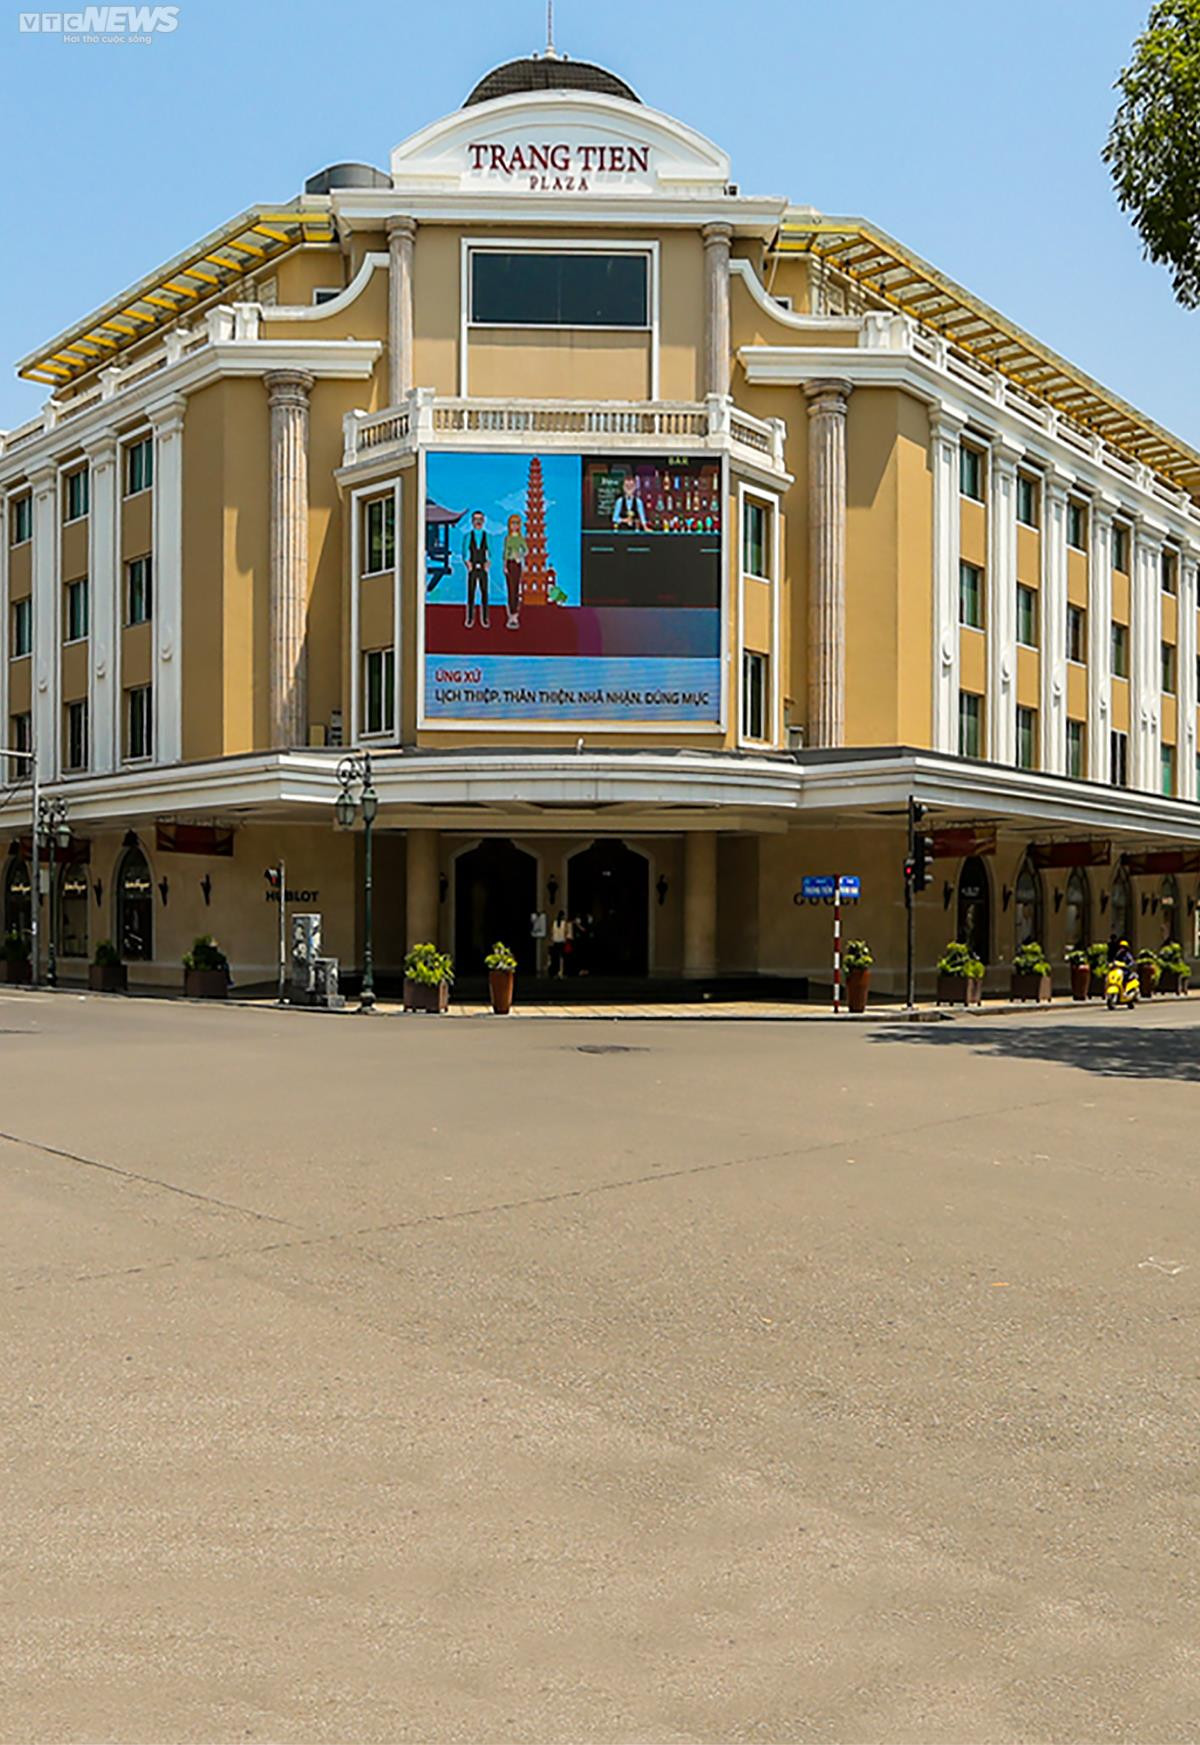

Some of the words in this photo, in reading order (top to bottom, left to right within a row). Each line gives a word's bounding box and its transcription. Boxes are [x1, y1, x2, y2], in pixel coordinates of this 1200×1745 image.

[468, 144, 570, 175] TRANG
[577, 146, 650, 173] TIEN
[530, 176, 588, 191] PLAZA
[668, 456, 689, 466] BAR
